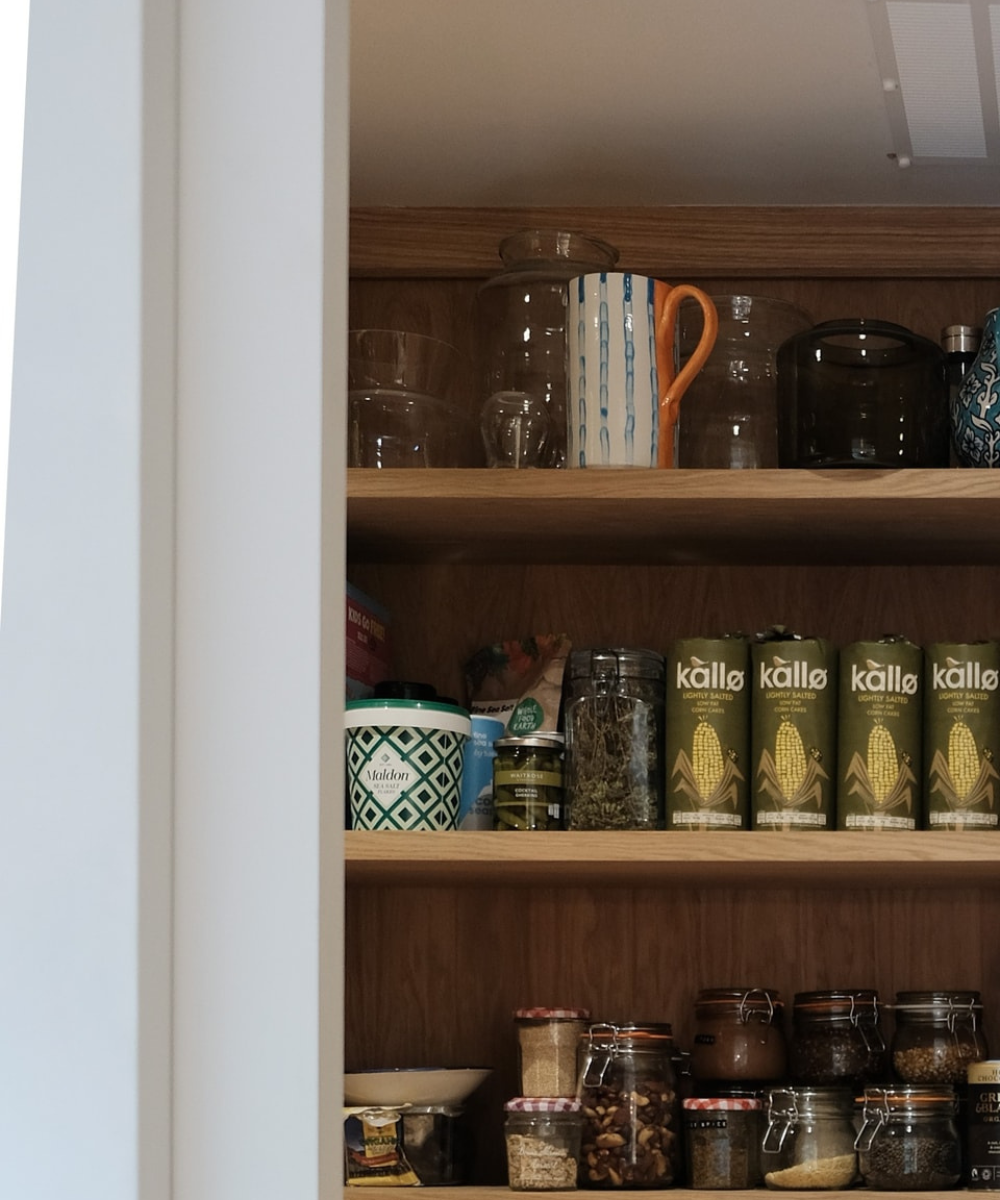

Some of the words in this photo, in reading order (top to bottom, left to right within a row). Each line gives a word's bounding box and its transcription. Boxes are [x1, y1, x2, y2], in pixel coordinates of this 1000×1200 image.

[710, 692, 734, 701] SALTED
[792, 692, 817, 700] SALTED
[885, 695, 909, 704] SALTED
[965, 692, 989, 700] SALTED
[513, 722, 537, 731] EARTH
[366, 768, 410, 781] Maldon
